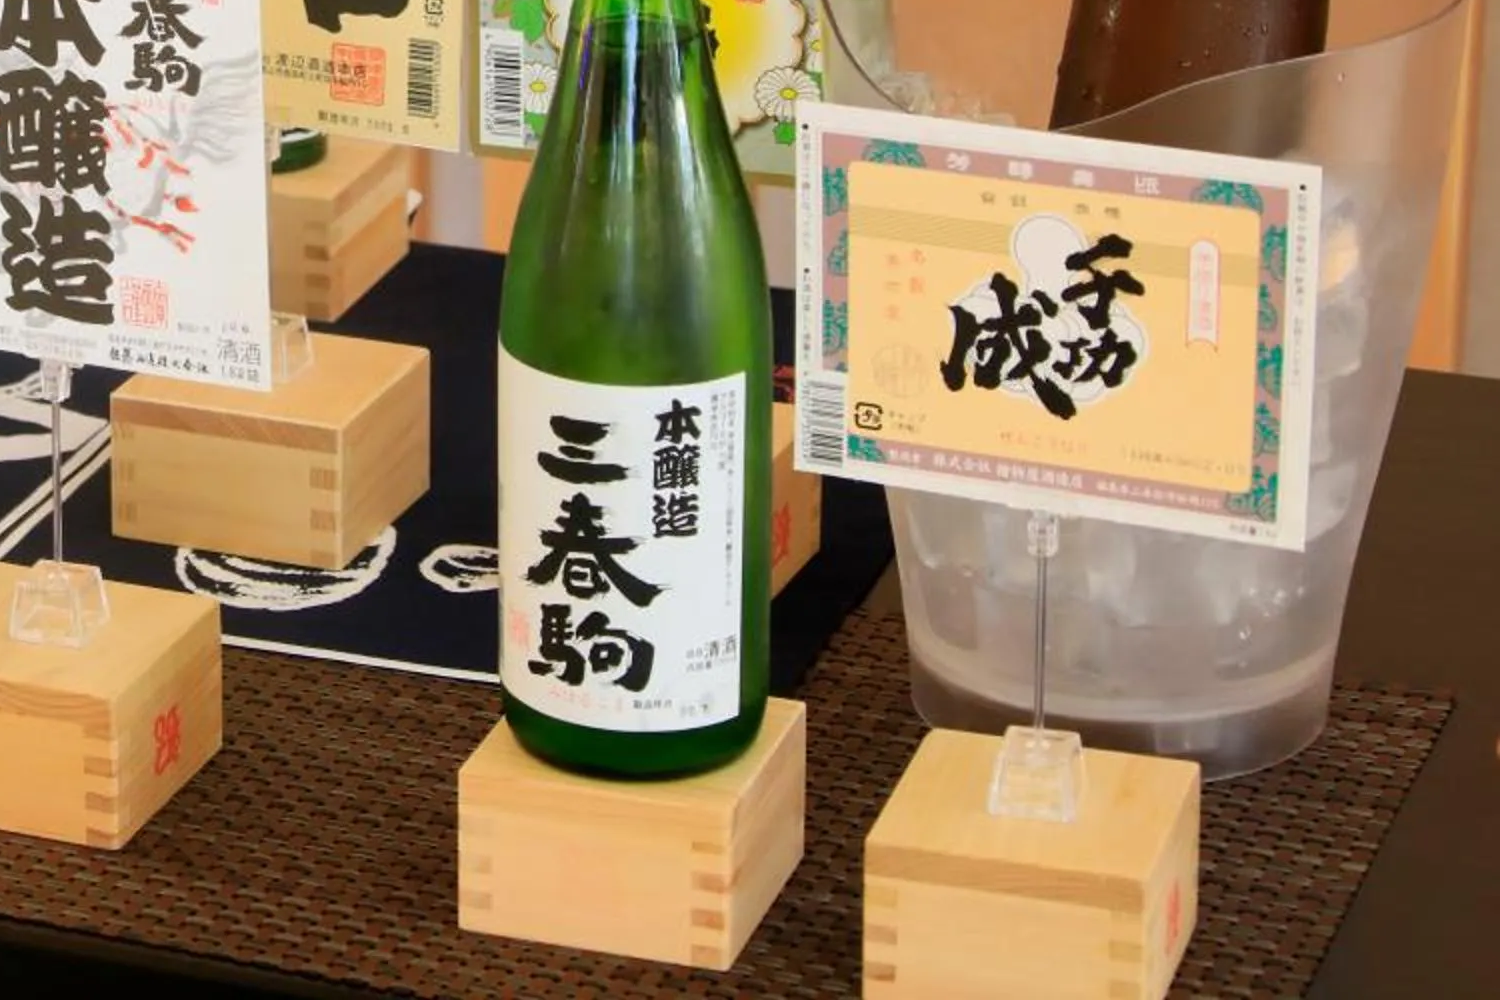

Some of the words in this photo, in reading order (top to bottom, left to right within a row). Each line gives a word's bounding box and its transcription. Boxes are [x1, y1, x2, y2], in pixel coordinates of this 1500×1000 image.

[216, 336, 261, 366] 清酒
[652, 398, 702, 538] 本醸造
[524, 415, 668, 692] 三春駒
